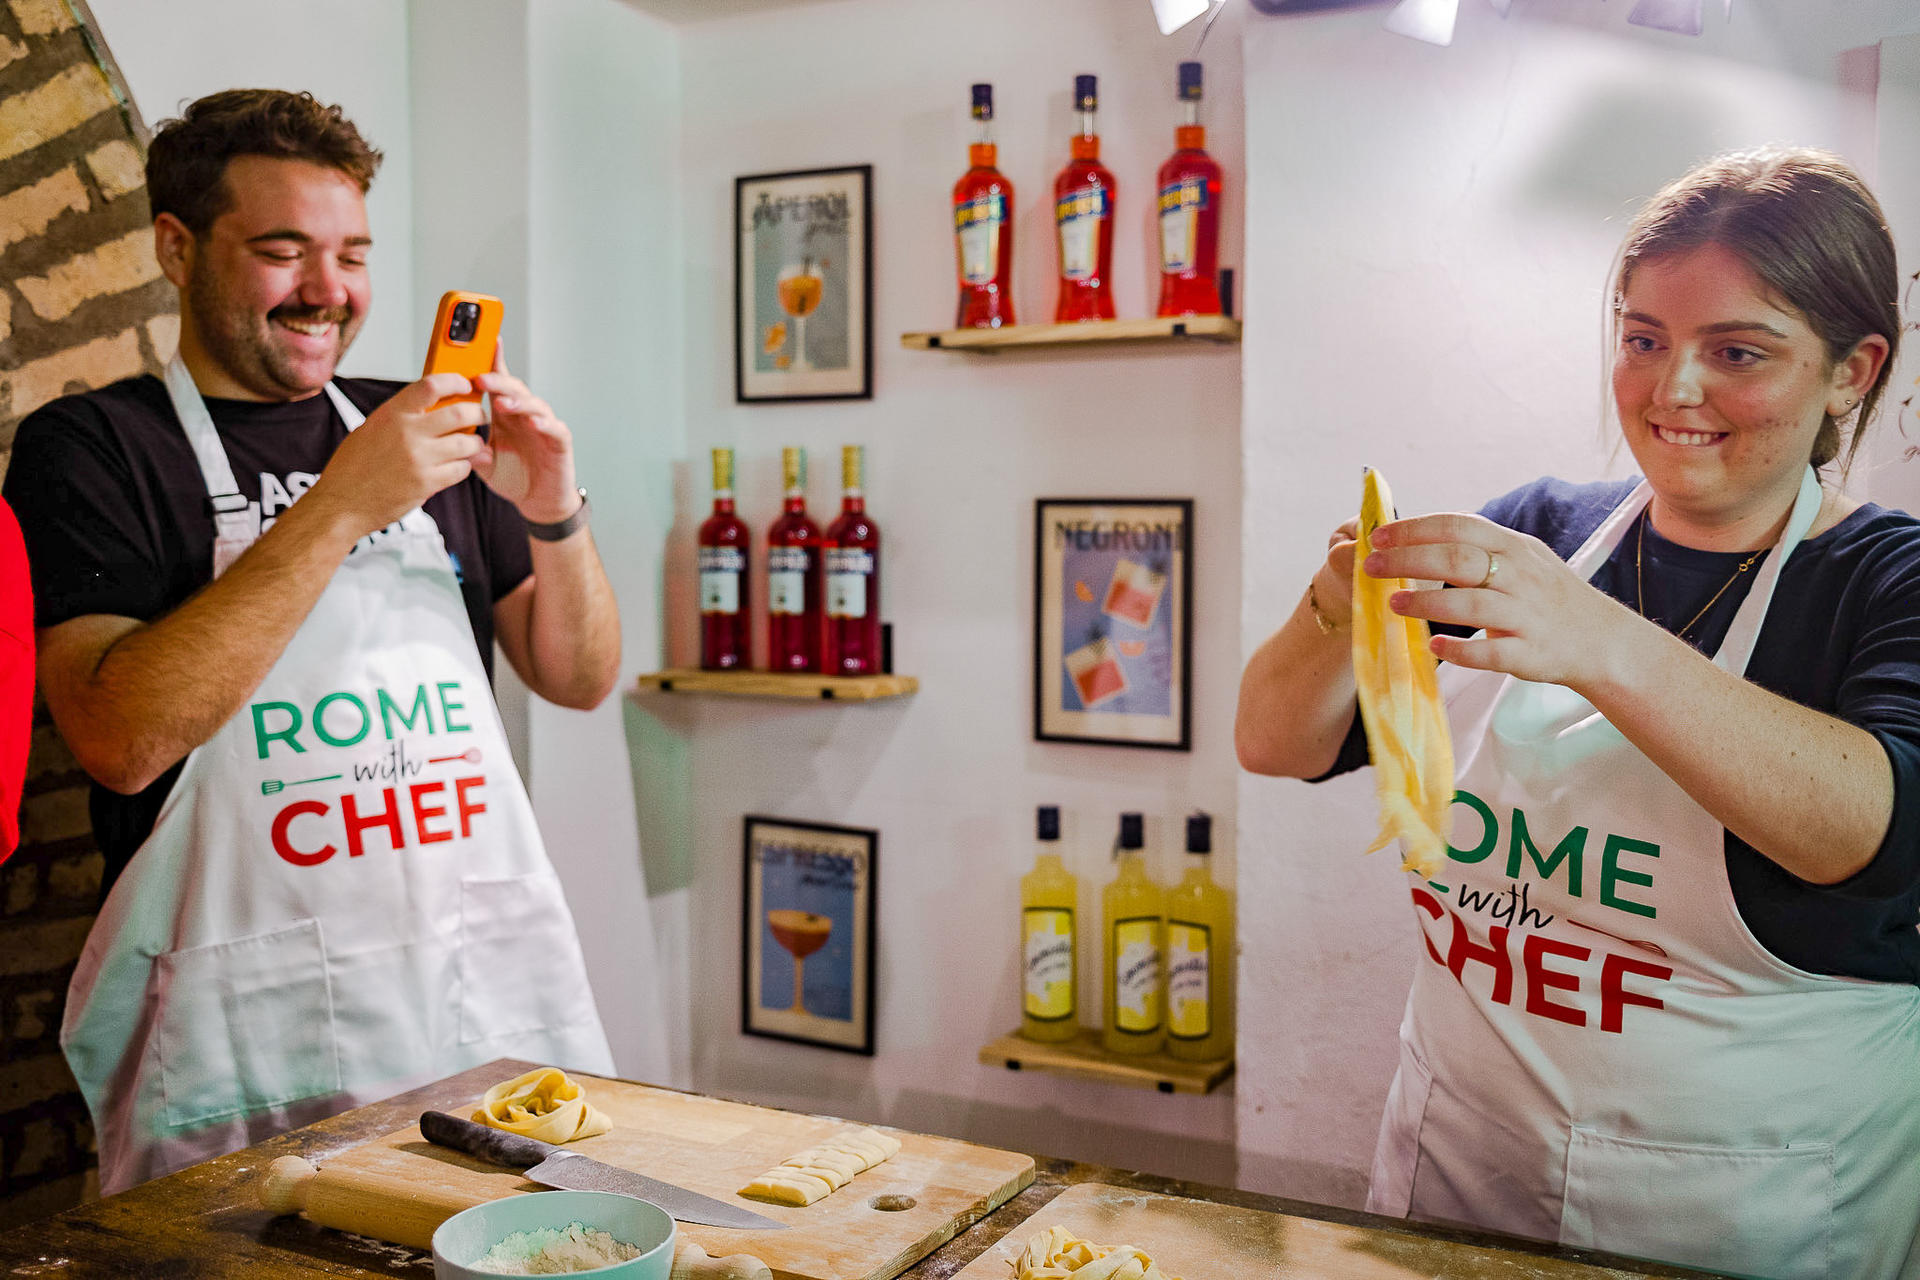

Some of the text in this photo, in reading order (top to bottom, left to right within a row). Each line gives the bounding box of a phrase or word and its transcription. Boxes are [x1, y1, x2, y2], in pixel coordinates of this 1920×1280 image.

[251, 682, 472, 760] ROME
[354, 738, 423, 784] with
[271, 775, 487, 867] CHEF
[1446, 790, 1660, 919] OME
[1458, 882, 1554, 929] with
